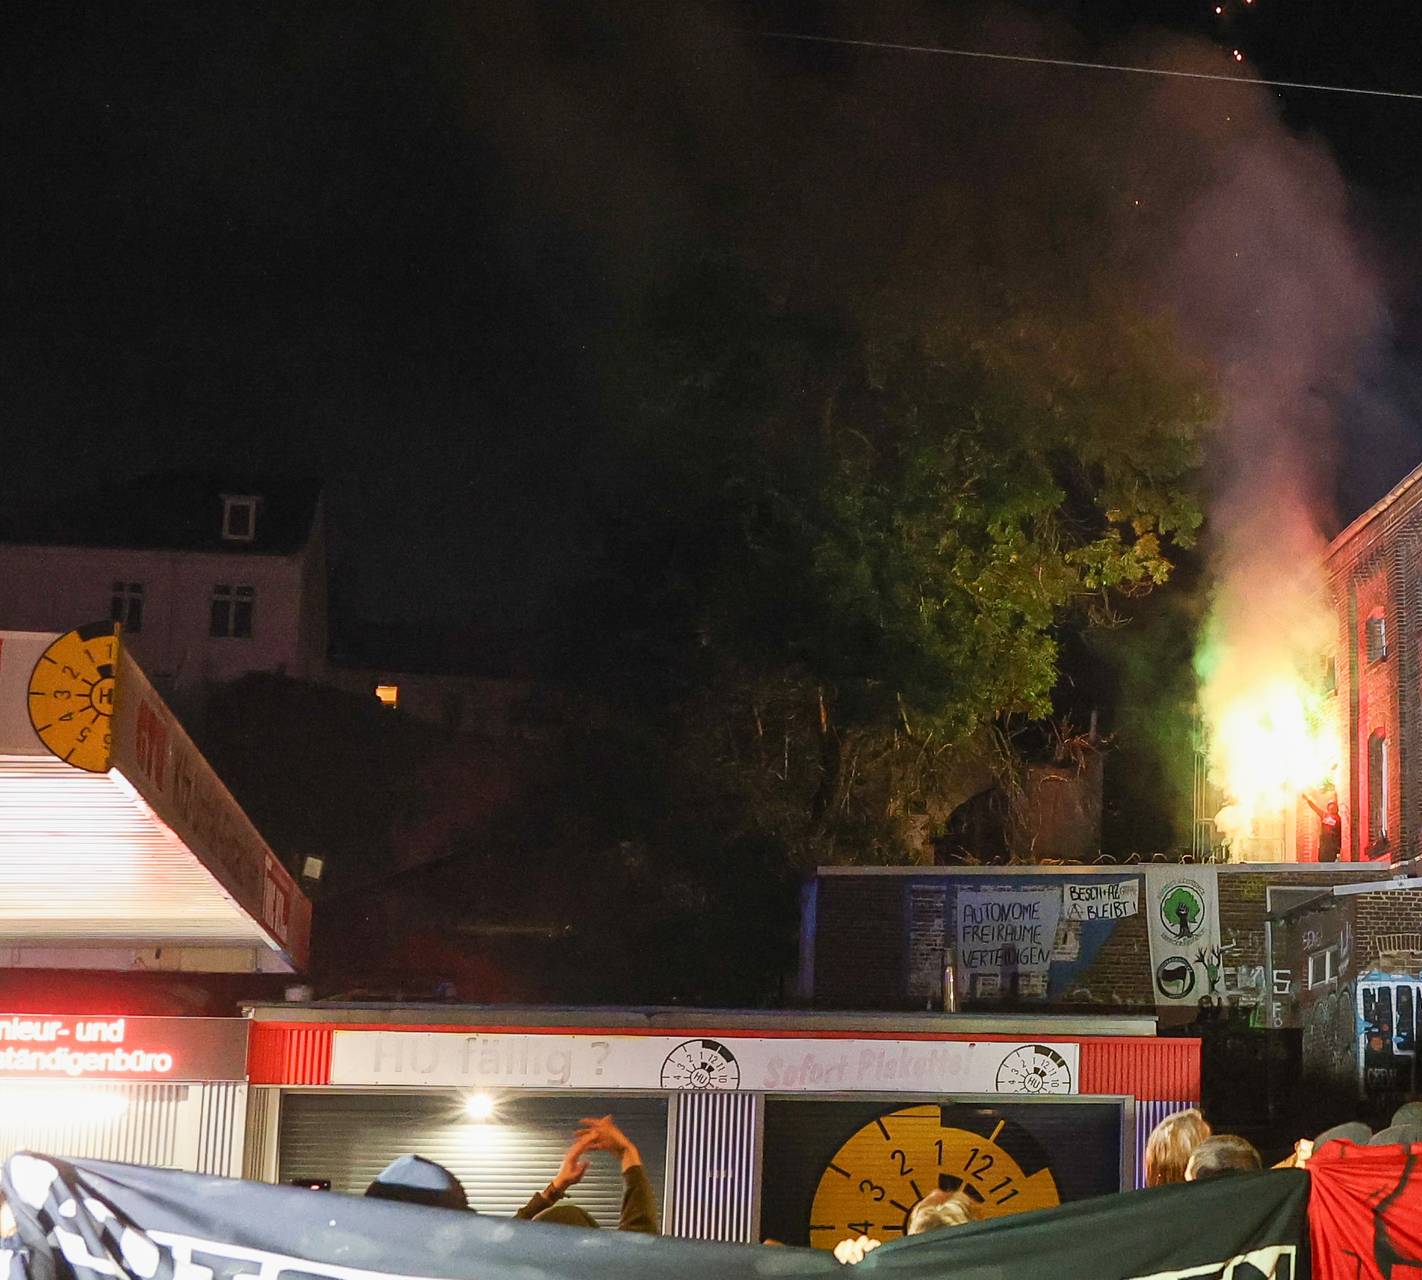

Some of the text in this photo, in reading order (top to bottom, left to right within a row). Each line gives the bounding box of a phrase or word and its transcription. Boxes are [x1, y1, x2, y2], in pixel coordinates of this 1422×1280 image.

[963, 900, 1041, 924] AUTONOME
[76, 1018, 125, 1042] und
[891, 1150, 913, 1175] 2
[934, 1139, 943, 1166] 1
[964, 1148, 994, 1181] 12
[859, 1179, 885, 1201] 3
[989, 1176, 1019, 1205] 11
